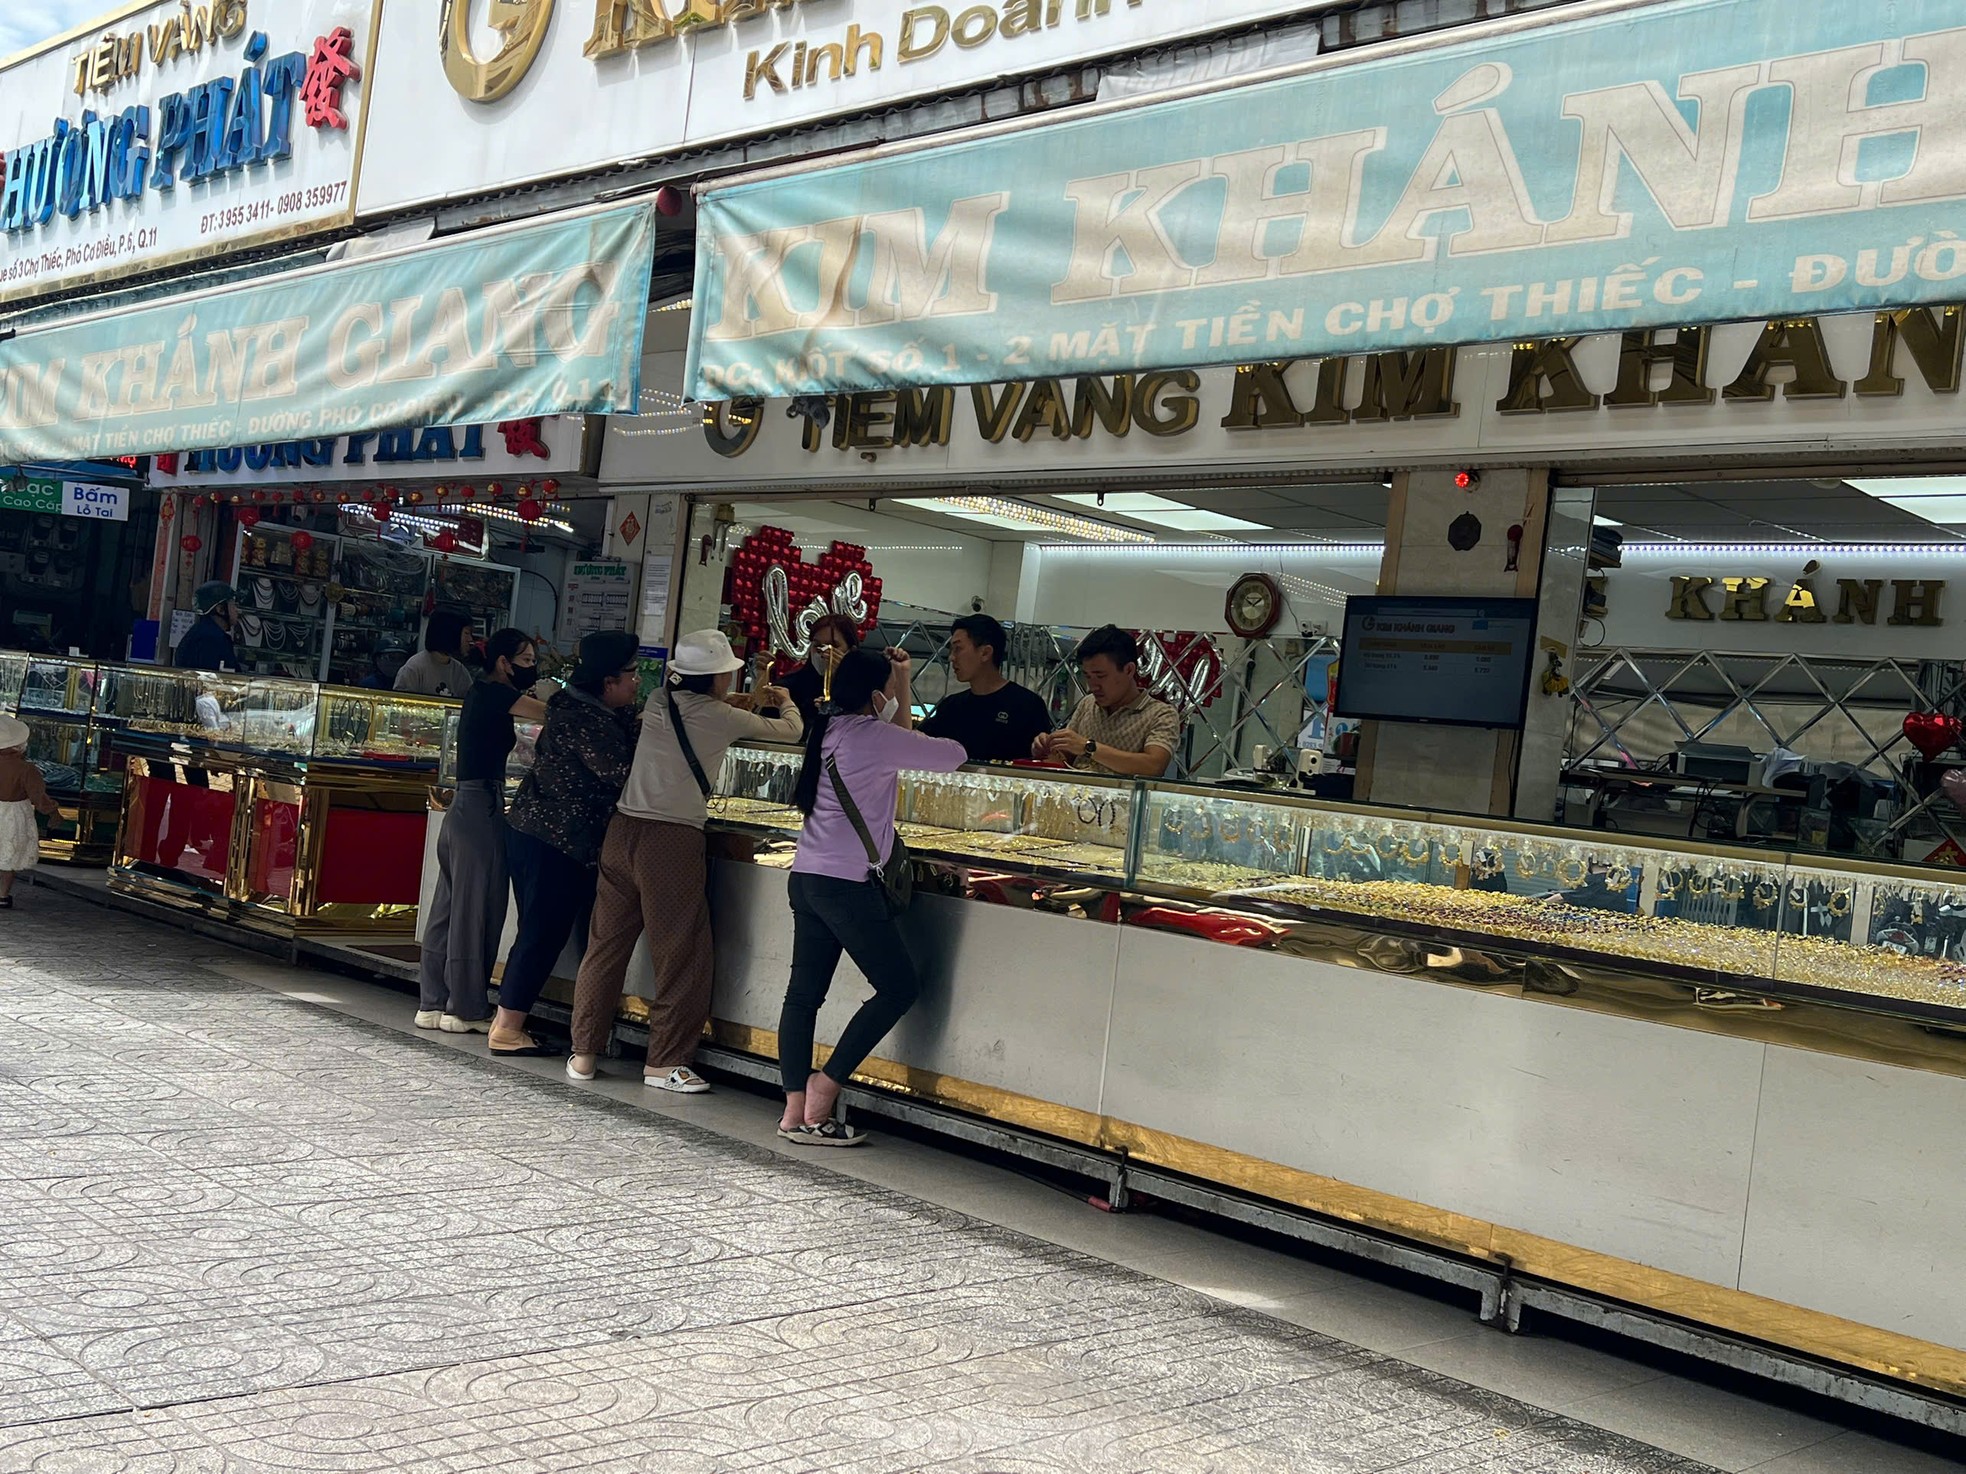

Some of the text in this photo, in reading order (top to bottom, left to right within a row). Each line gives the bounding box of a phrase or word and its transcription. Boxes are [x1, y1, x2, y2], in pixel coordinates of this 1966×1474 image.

[743, 23, 883, 101] Kinh
[150, 30, 306, 190] PHÁT
[277, 191, 303, 215] 0908
[304, 180, 348, 209] 359977
[705, 27, 1966, 342] KIM KHÁNH
[138, 226, 158, 249] Q.11
[73, 313, 310, 423] KHÁNH
[326, 261, 619, 391] GIANG
[942, 342, 960, 372] 1
[1003, 335, 1032, 365] 2
[1175, 300, 1304, 351] TIỀN
[1324, 286, 1462, 336] CHỢ
[1480, 256, 1703, 321] THIẾC
[1221, 344, 1461, 431] KIM
[3, 496, 31, 507] Cao
[74, 487, 118, 504] Bấm
[95, 506, 113, 518] Tai
[1664, 559, 1947, 627] KHÁNH
